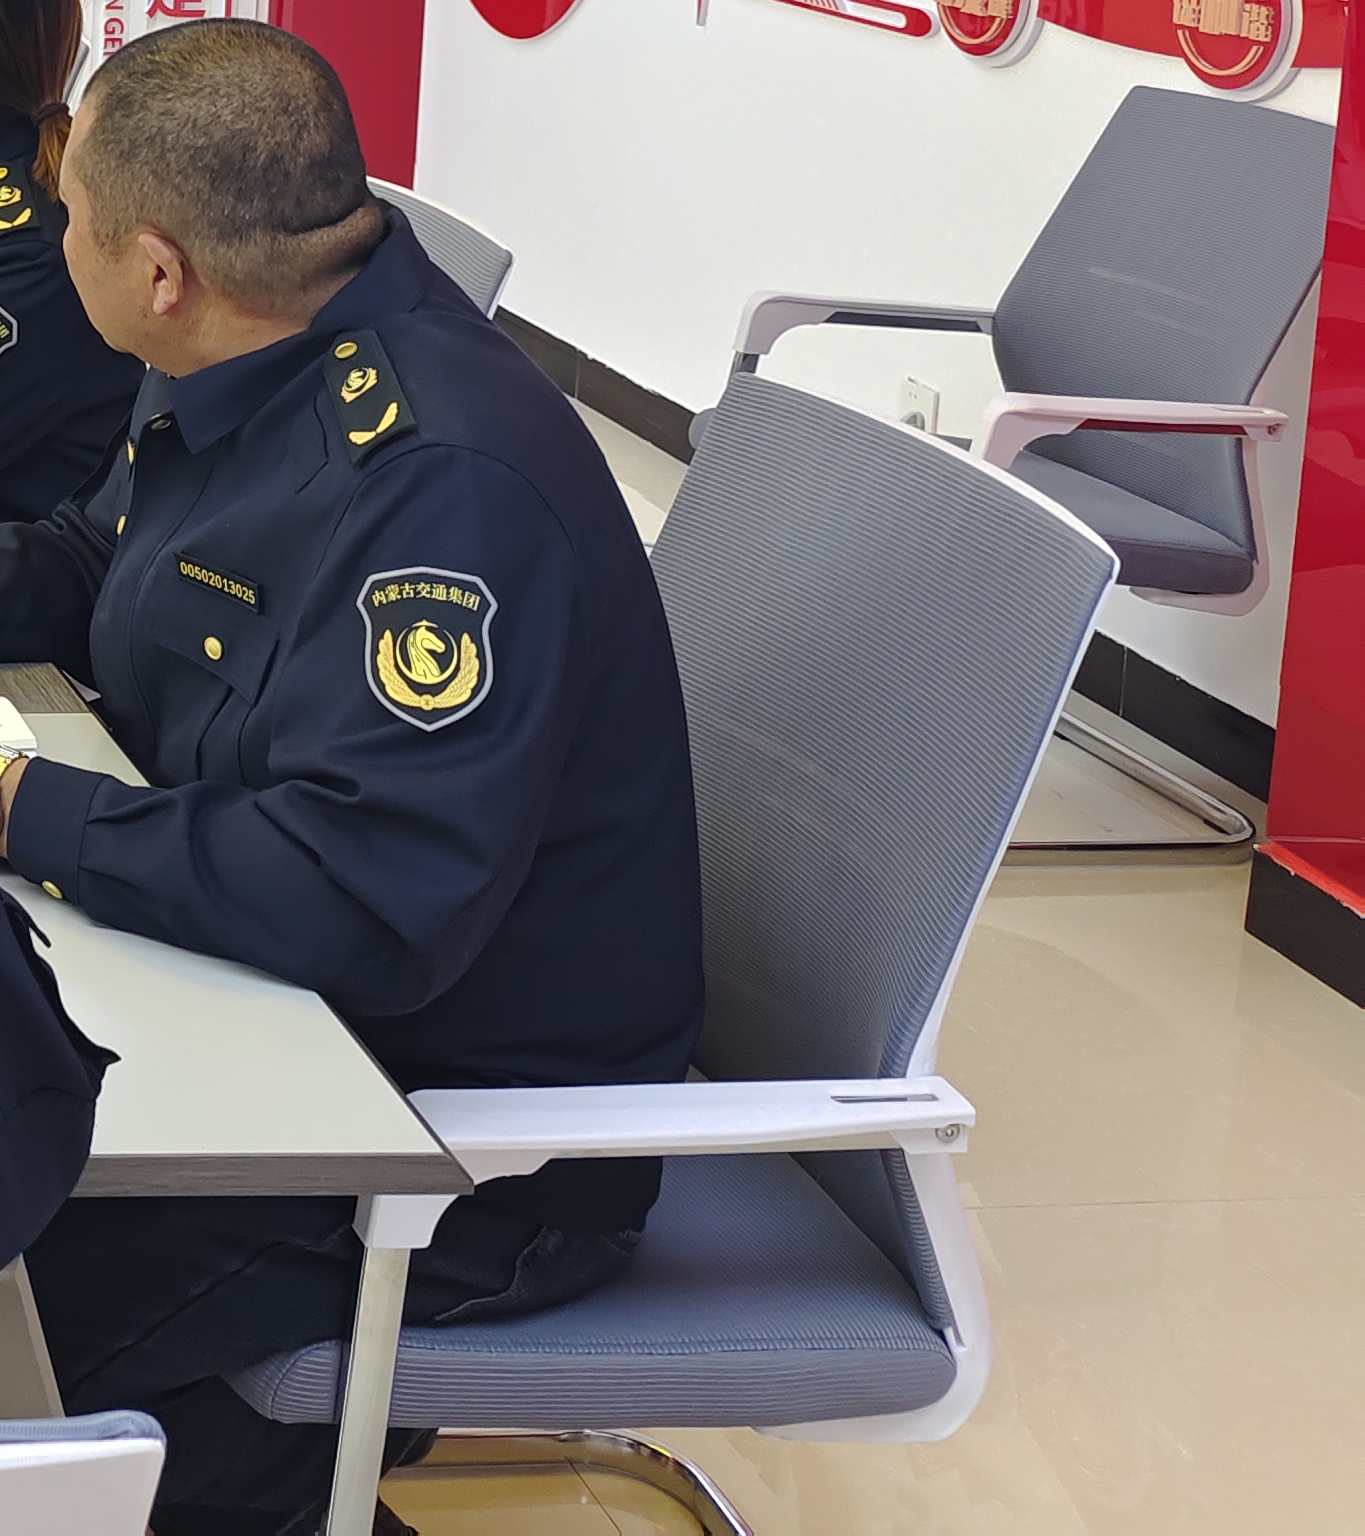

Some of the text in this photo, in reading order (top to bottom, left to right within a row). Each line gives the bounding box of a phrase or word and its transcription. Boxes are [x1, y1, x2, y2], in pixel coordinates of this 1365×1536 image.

[180, 561, 256, 604] 00502013025
[372, 582, 482, 612] 内蒙古交通集团
